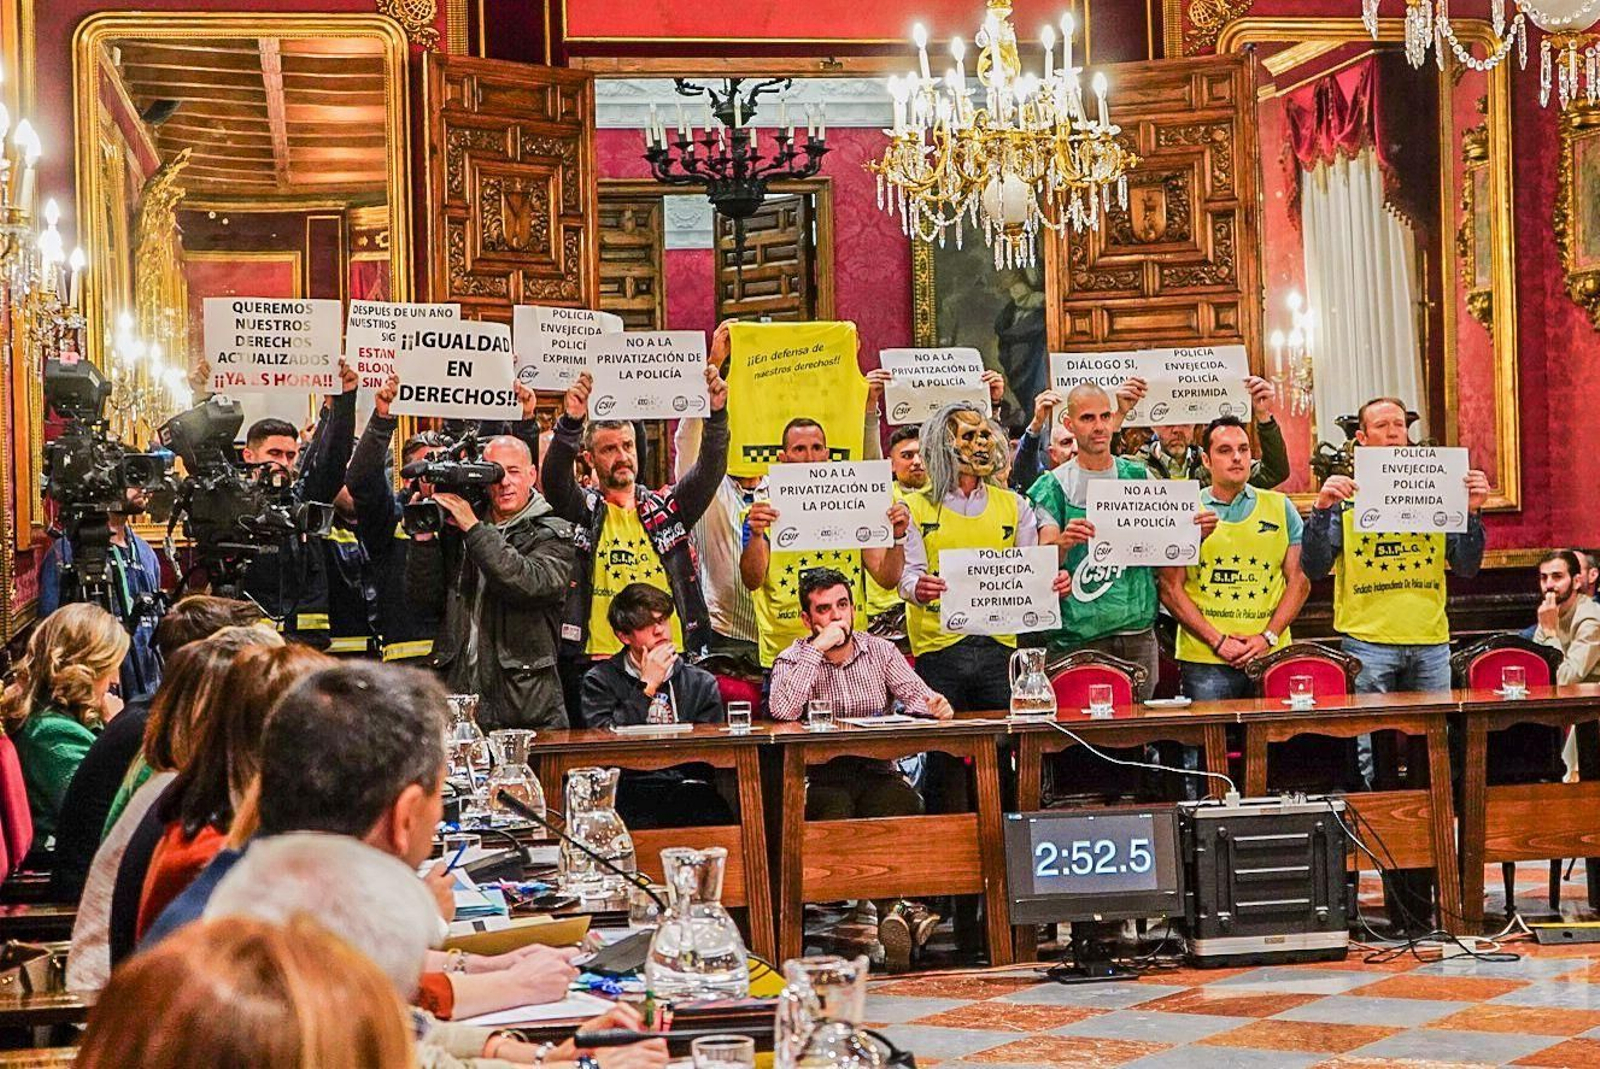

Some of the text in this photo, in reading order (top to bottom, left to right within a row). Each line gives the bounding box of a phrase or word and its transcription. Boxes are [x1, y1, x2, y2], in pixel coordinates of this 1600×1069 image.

[232, 301, 313, 314] QUEREMOS
[393, 307, 408, 317] DE
[410, 307, 426, 318] UN
[429, 306, 453, 318] AÑO
[235, 318, 311, 331] NUESTROS
[350, 316, 397, 330] NUESTROS
[235, 335, 312, 348] DERECHOS
[401, 330, 510, 353] ¡¡IGUALDAD
[626, 337, 673, 348] NO A LA
[597, 350, 702, 364] PRIVATIZACIÓN DE
[771, 347, 810, 361] defensa
[812, 342, 824, 353] de
[914, 352, 954, 362] NO A LA
[217, 352, 330, 366] ACTUALIZADOS
[1066, 357, 1121, 370] DIÁLOGO
[447, 360, 473, 378] EN
[619, 367, 682, 380] LA POLICÍA
[754, 355, 841, 380] nuestros derechos!!
[891, 364, 980, 376] PRIVATIZACIÓN DE
[214, 371, 333, 388] ¡¡YA ES HORA!!
[362, 377, 383, 388] SIN
[912, 376, 967, 389] LA POLICÍA
[1178, 373, 1219, 384] POLICÍA
[399, 384, 518, 407] DERECHOS!!
[1171, 387, 1228, 399] EXPRIMIDA
[809, 467, 856, 479] NO A LA
[780, 481, 886, 496] PRIVATIZACIÓN DE
[1393, 478, 1436, 489] POLICÍA
[1124, 486, 1167, 495] NO A LA
[802, 497, 866, 511] LA POLICÍA
[1096, 500, 1195, 512] PRIVATIZACIÓN DE
[1384, 495, 1444, 505] EXPRIMIDA
[1117, 515, 1176, 528] LA POLICÍA
[979, 577, 1023, 591] POLICÍA
[971, 596, 1033, 607] EXPRIMIDA
[1035, 838, 1152, 877] 2:52.5
